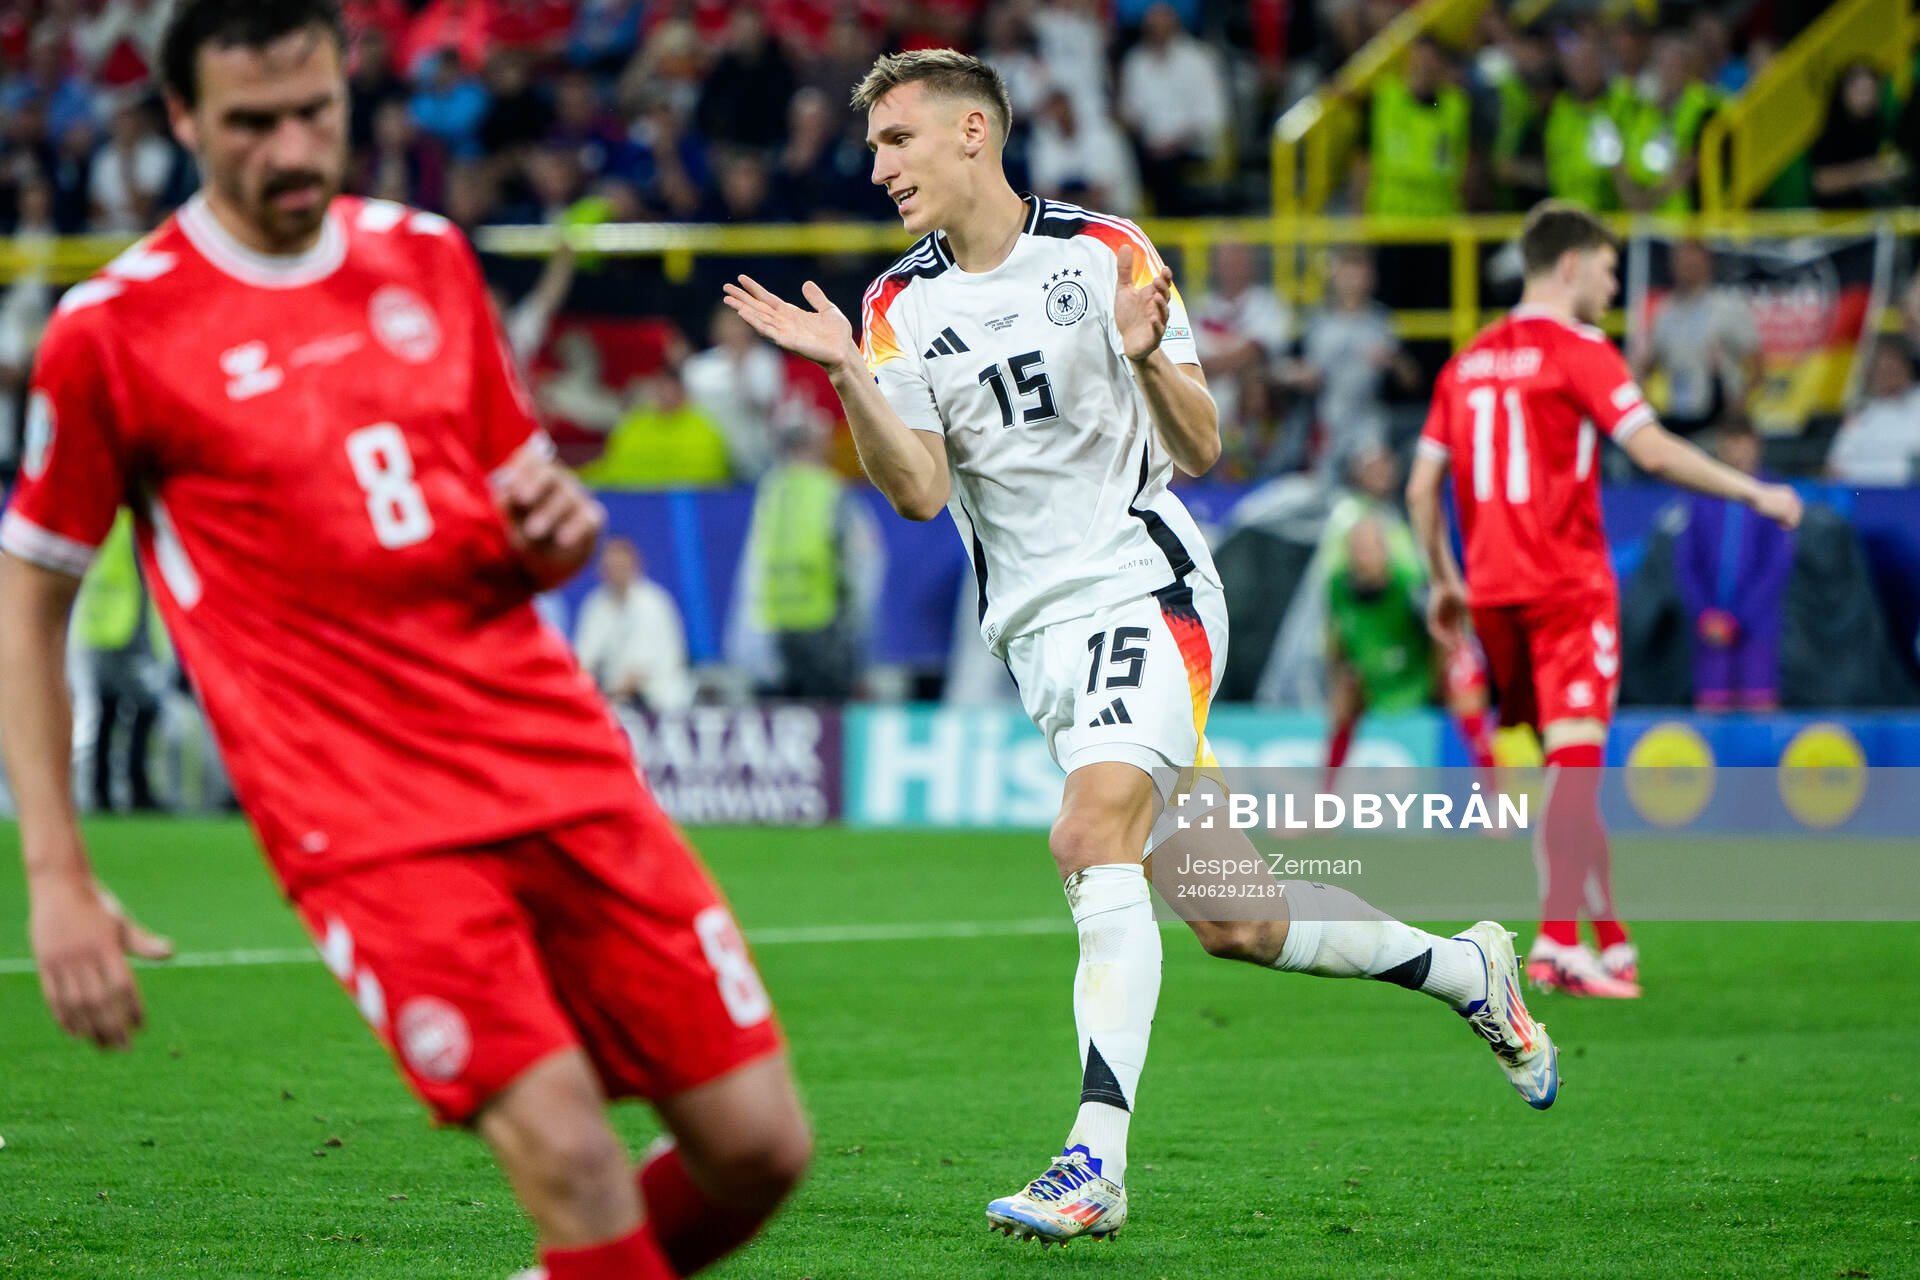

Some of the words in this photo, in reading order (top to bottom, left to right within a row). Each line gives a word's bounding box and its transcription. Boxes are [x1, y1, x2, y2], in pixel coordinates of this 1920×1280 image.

[978, 350, 1058, 428] 15
[1467, 386, 1530, 503] 11
[345, 421, 435, 550] 8
[1086, 626, 1150, 695] 15
[694, 906, 772, 1028] 8
